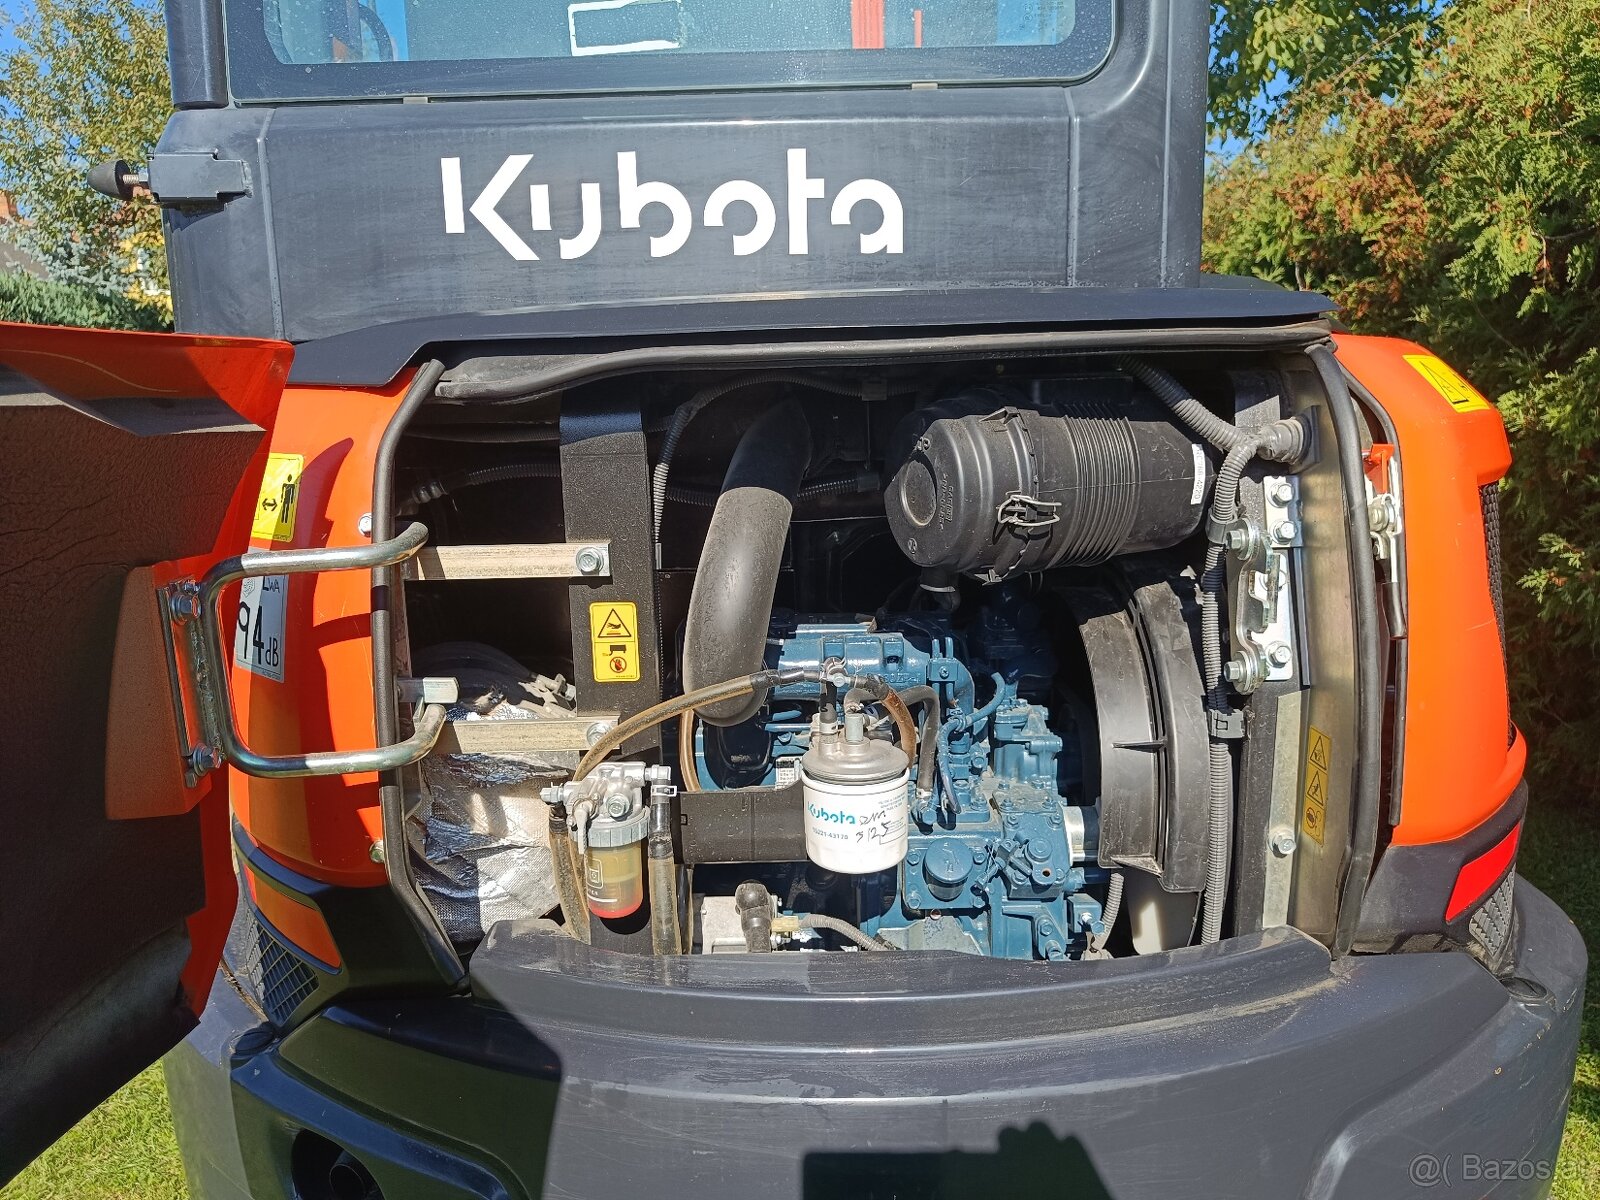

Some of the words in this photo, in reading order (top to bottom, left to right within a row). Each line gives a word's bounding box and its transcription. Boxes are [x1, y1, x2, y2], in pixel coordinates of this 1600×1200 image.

[440, 147, 904, 261] Kubota
[238, 601, 265, 665] 94
[265, 636, 279, 667] dB
[807, 801, 856, 825] Kubota
